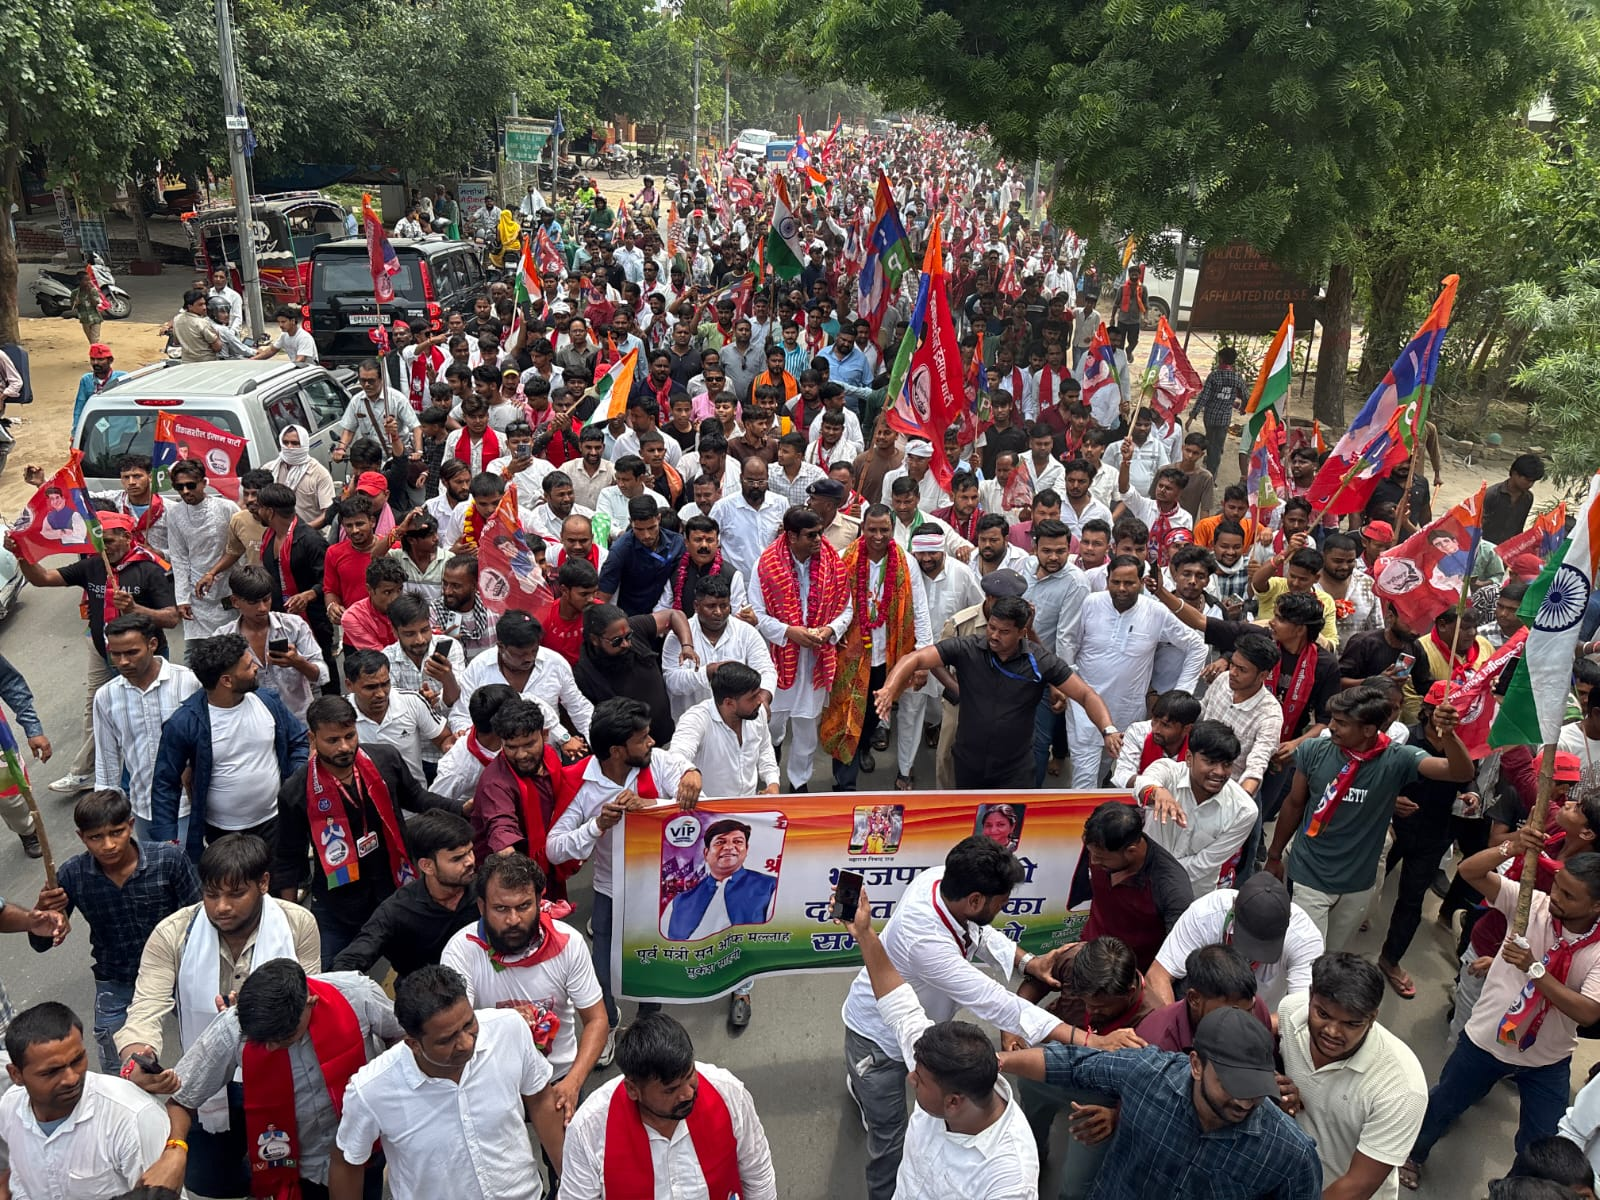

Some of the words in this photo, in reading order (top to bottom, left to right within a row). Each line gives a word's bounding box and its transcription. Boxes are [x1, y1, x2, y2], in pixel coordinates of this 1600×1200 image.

[1200, 290, 1262, 302] AFFILIATED
[1263, 289, 1274, 301] TO
[671, 826, 696, 837] VIP
[635, 945, 658, 964] पूर्व
[663, 947, 689, 961] मंत्री
[694, 945, 714, 960] सन
[748, 932, 792, 943] मल्लाह
[687, 963, 716, 979] मुकेश
[718, 948, 742, 968] साहनी
